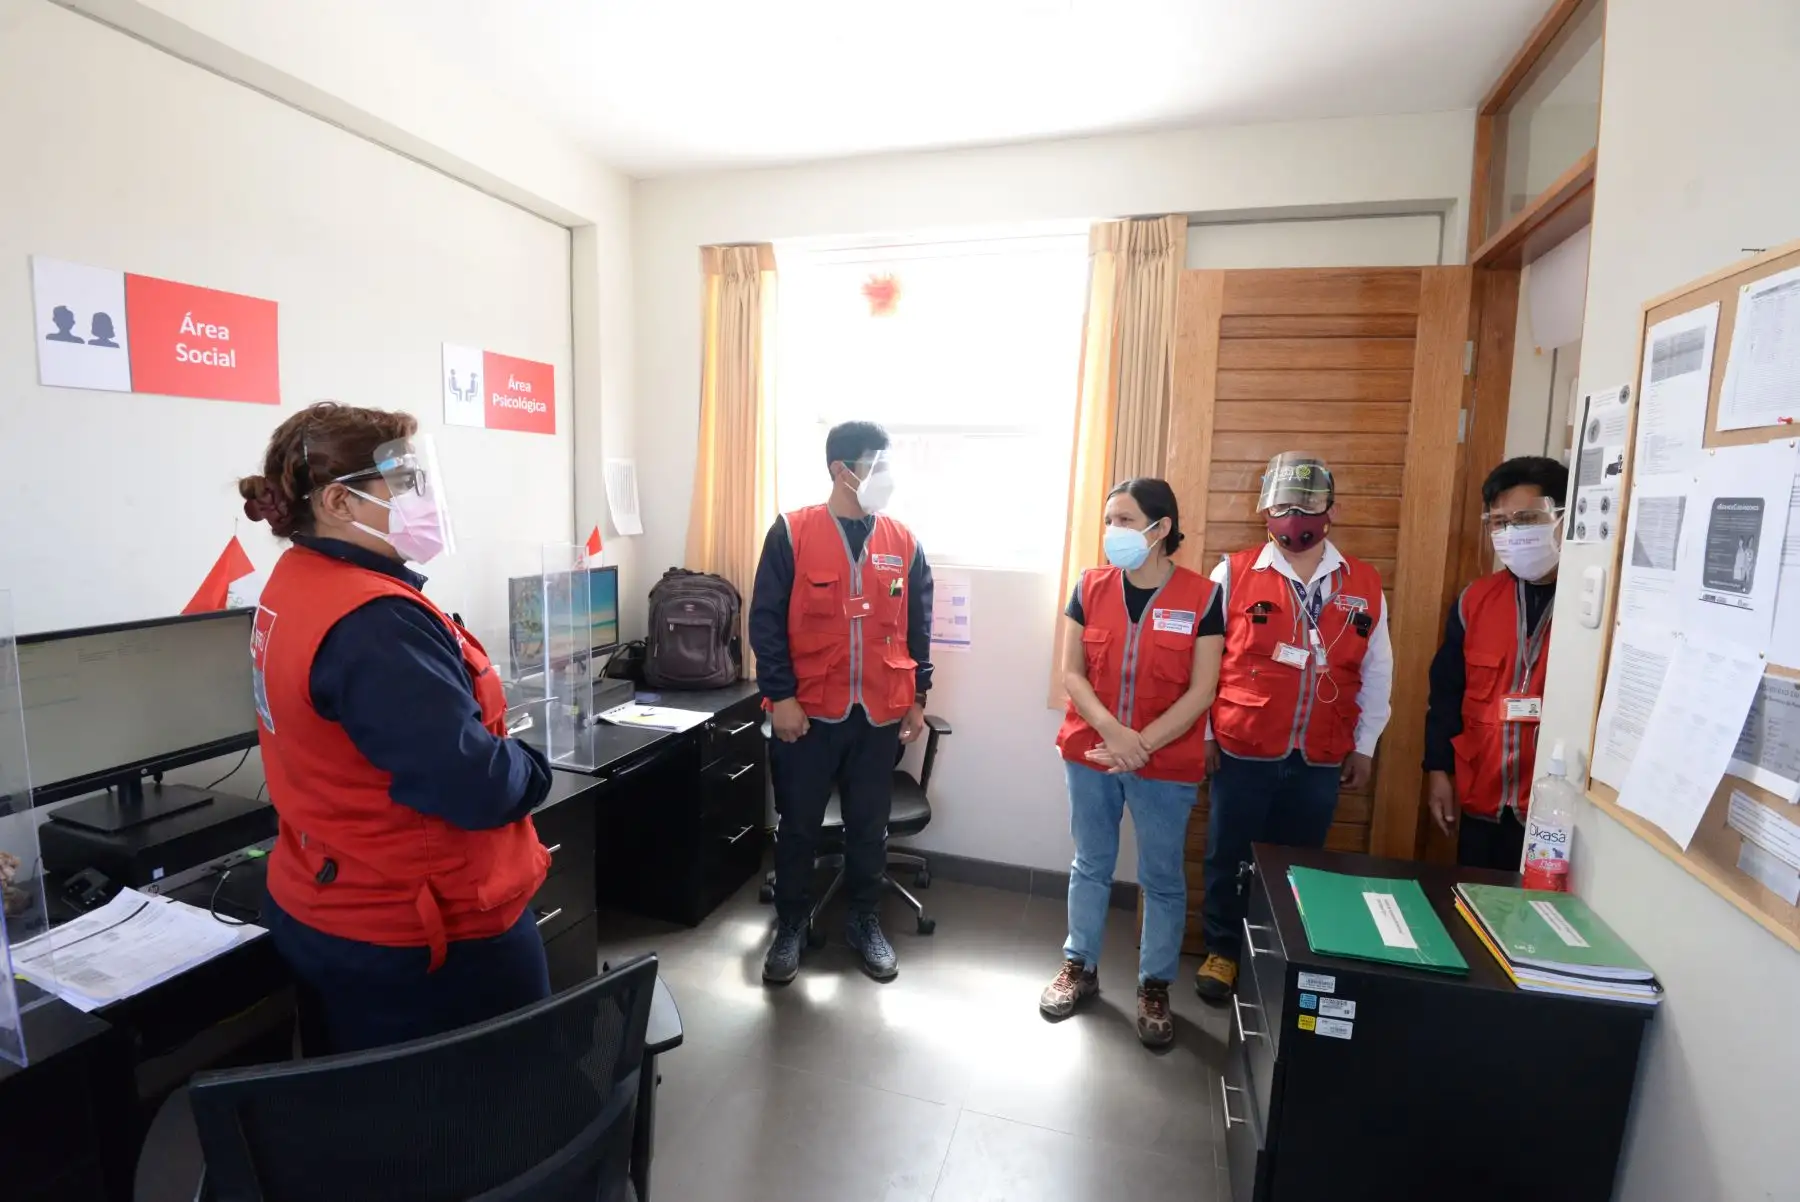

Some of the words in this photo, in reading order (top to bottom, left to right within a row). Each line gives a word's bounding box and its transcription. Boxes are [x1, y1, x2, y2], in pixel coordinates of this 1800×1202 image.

[180, 311, 230, 341] Área
[175, 342, 236, 368] Social
[508, 374, 532, 392] Área
[492, 393, 547, 414] Psicológica
